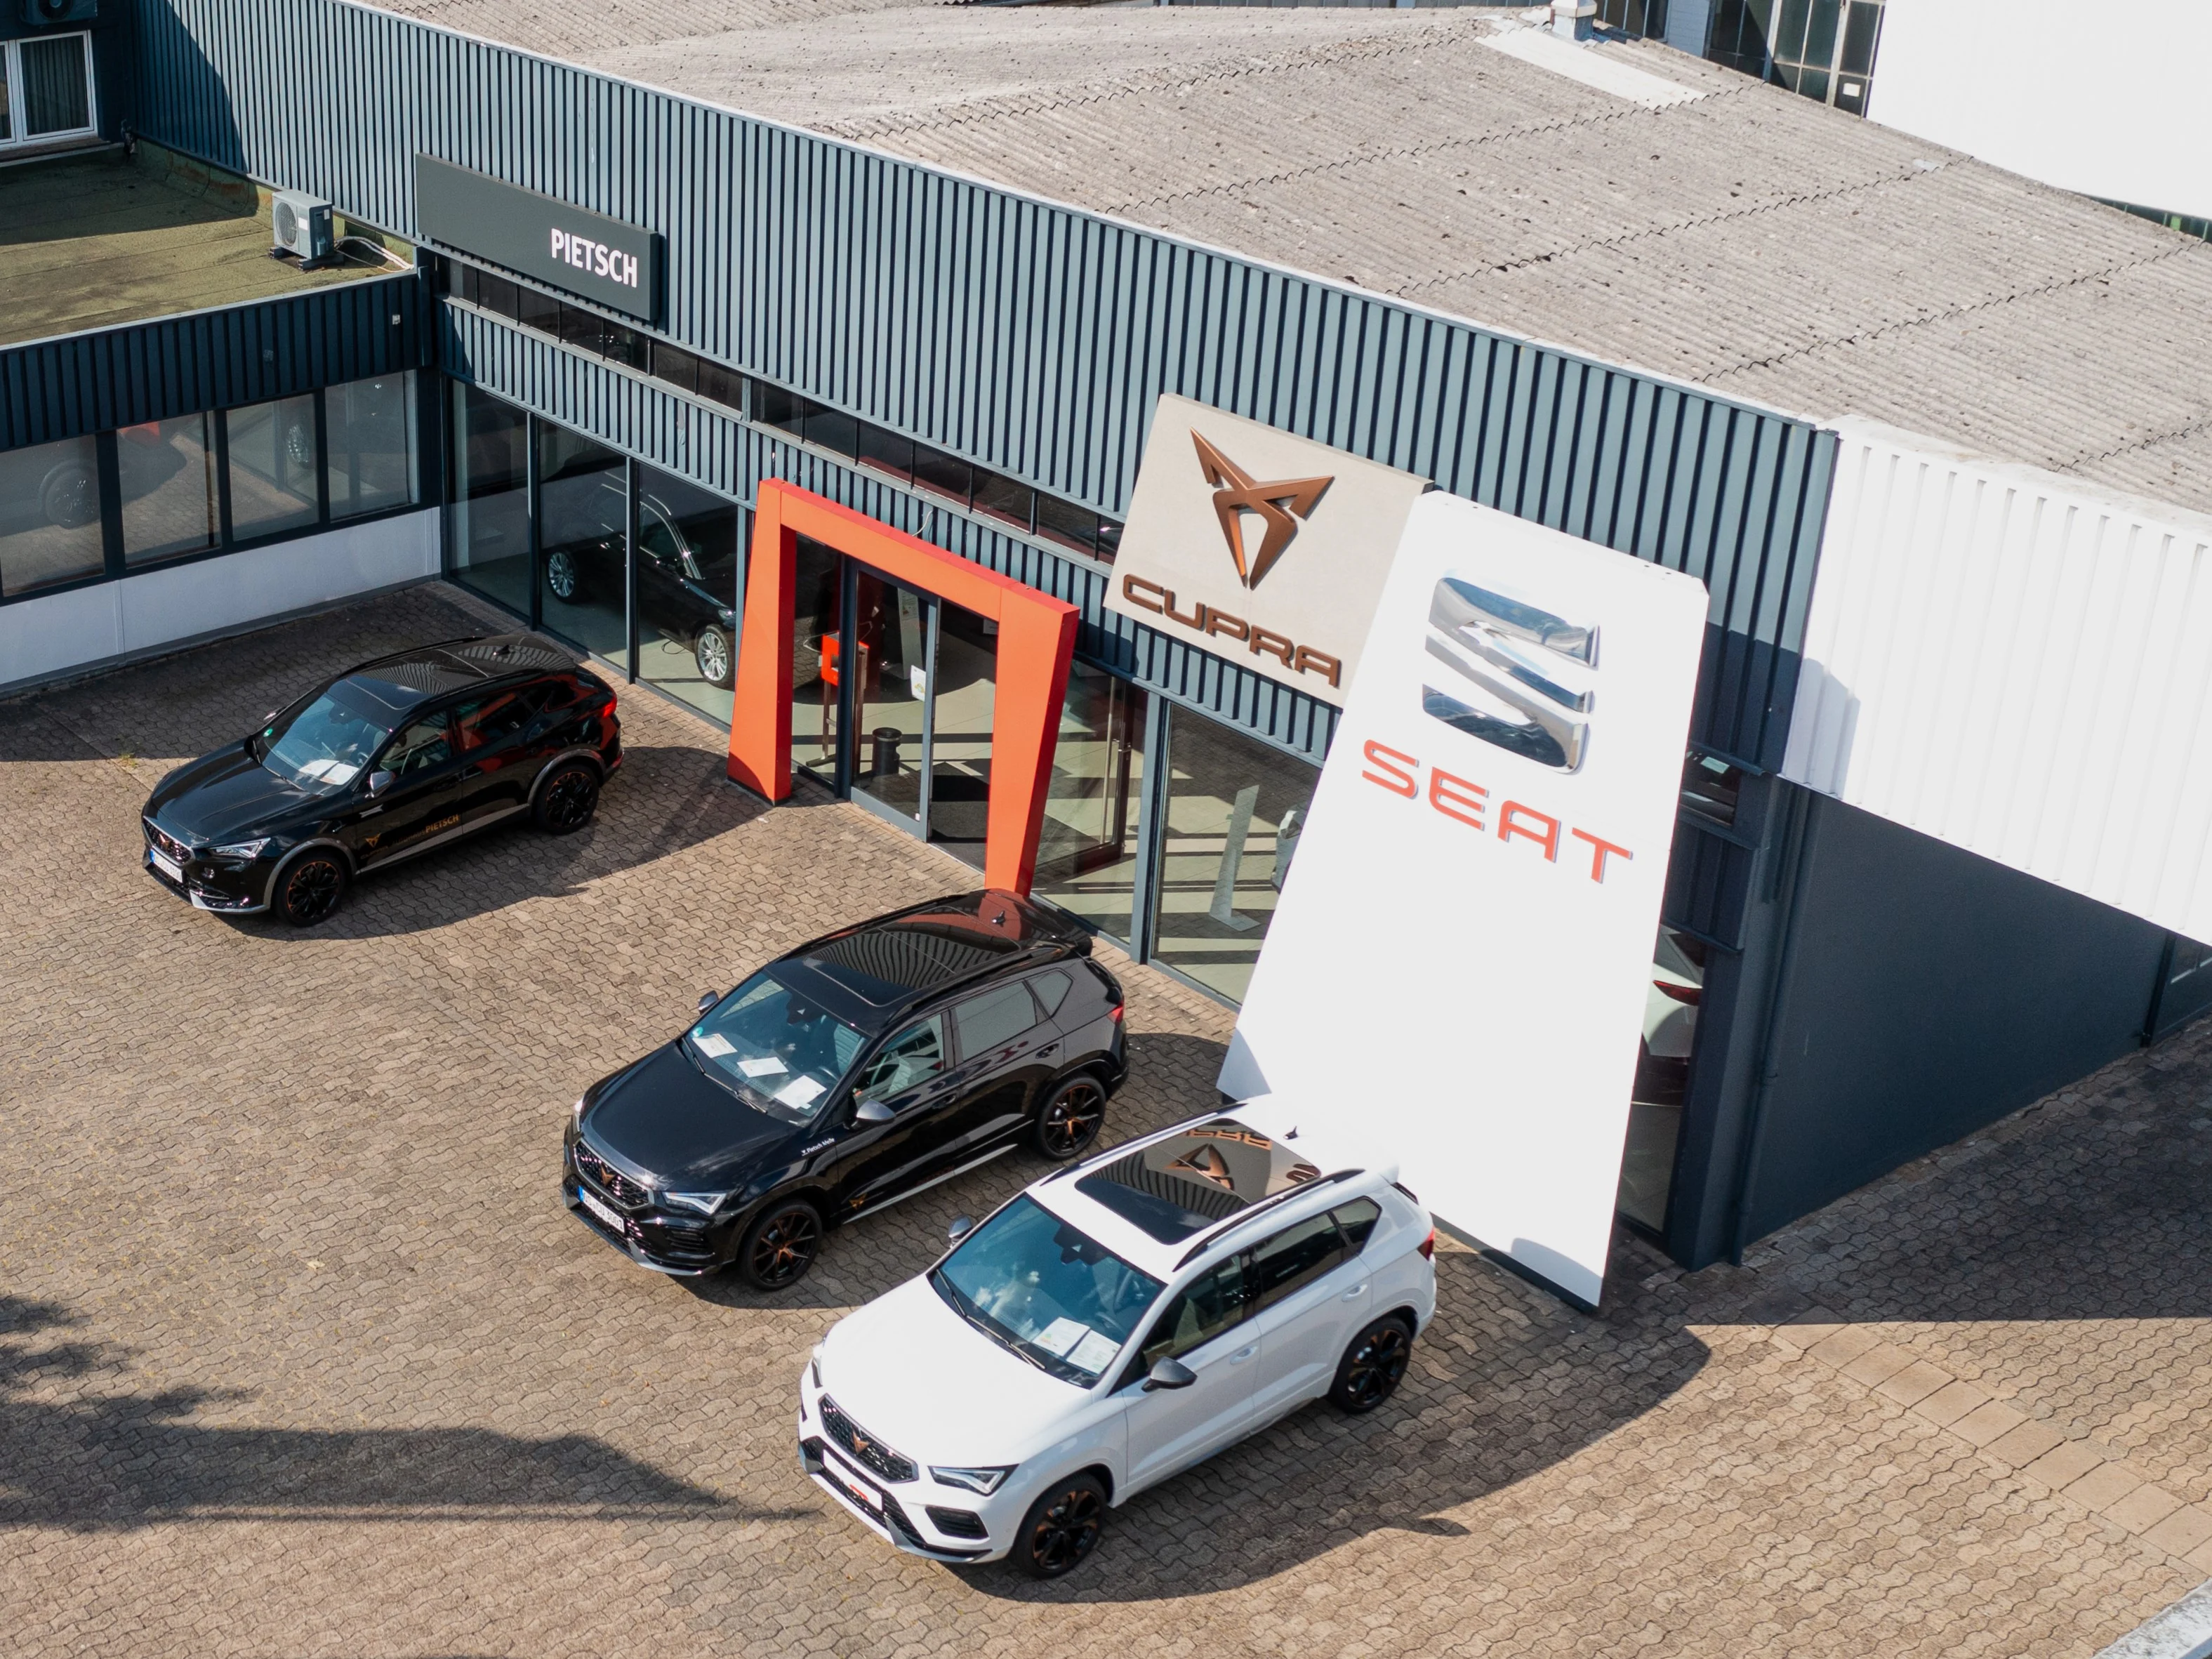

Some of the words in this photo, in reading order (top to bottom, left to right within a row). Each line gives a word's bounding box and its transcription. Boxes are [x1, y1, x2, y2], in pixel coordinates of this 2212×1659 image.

[551, 227, 637, 288] PIETSCH
[1122, 574, 1342, 689] CUPRA
[425, 814, 459, 833] PIETSCH
[1362, 739, 1634, 884] SEAT
